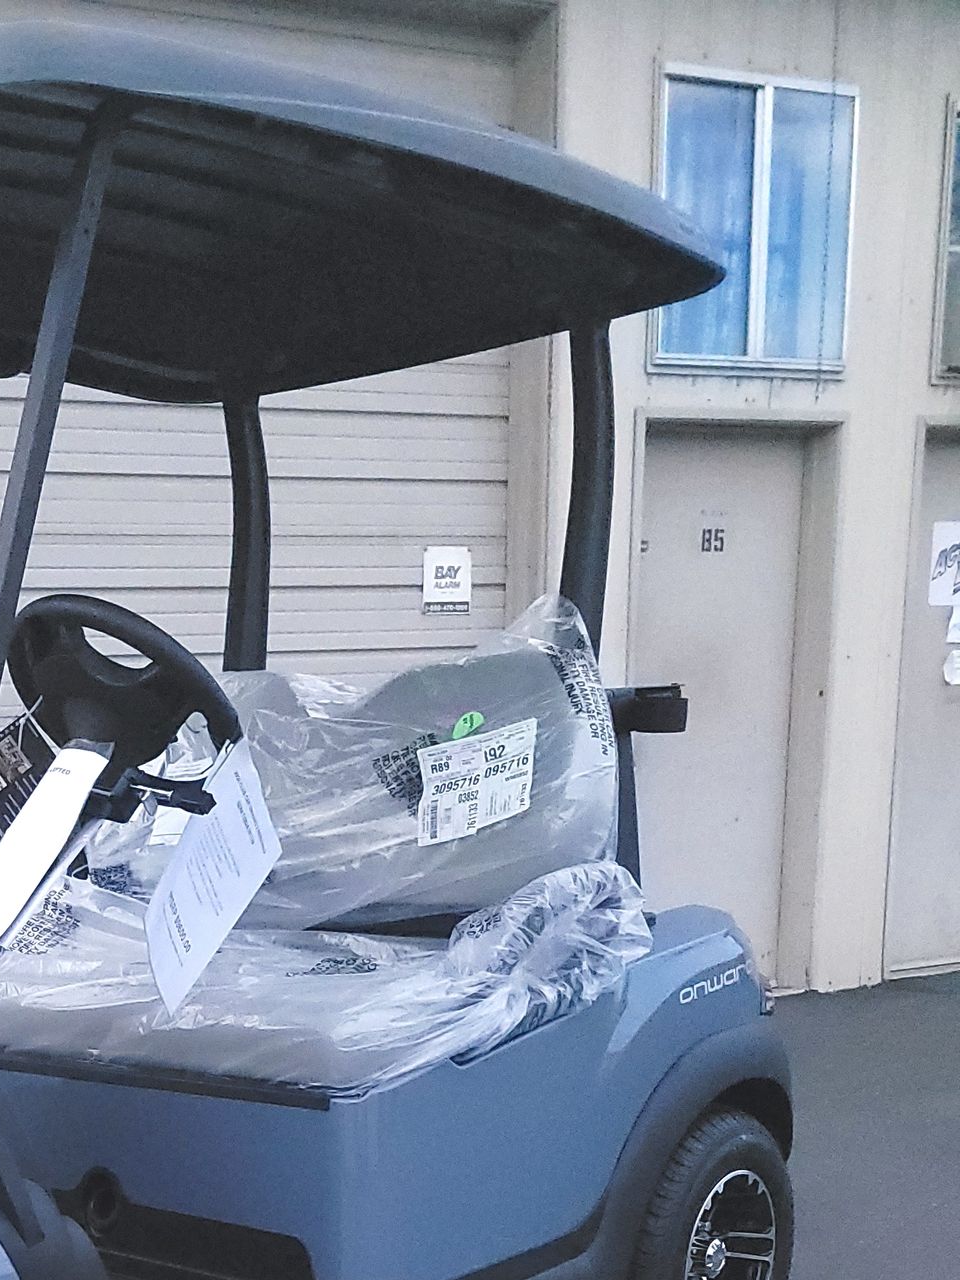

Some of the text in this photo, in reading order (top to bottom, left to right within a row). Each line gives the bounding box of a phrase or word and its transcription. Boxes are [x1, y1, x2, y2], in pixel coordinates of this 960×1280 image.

[701, 528, 725, 552] B5
[434, 566, 461, 579] BAY
[431, 762, 450, 774] R89
[484, 753, 529, 778] 095716
[431, 774, 481, 796] 3095716
